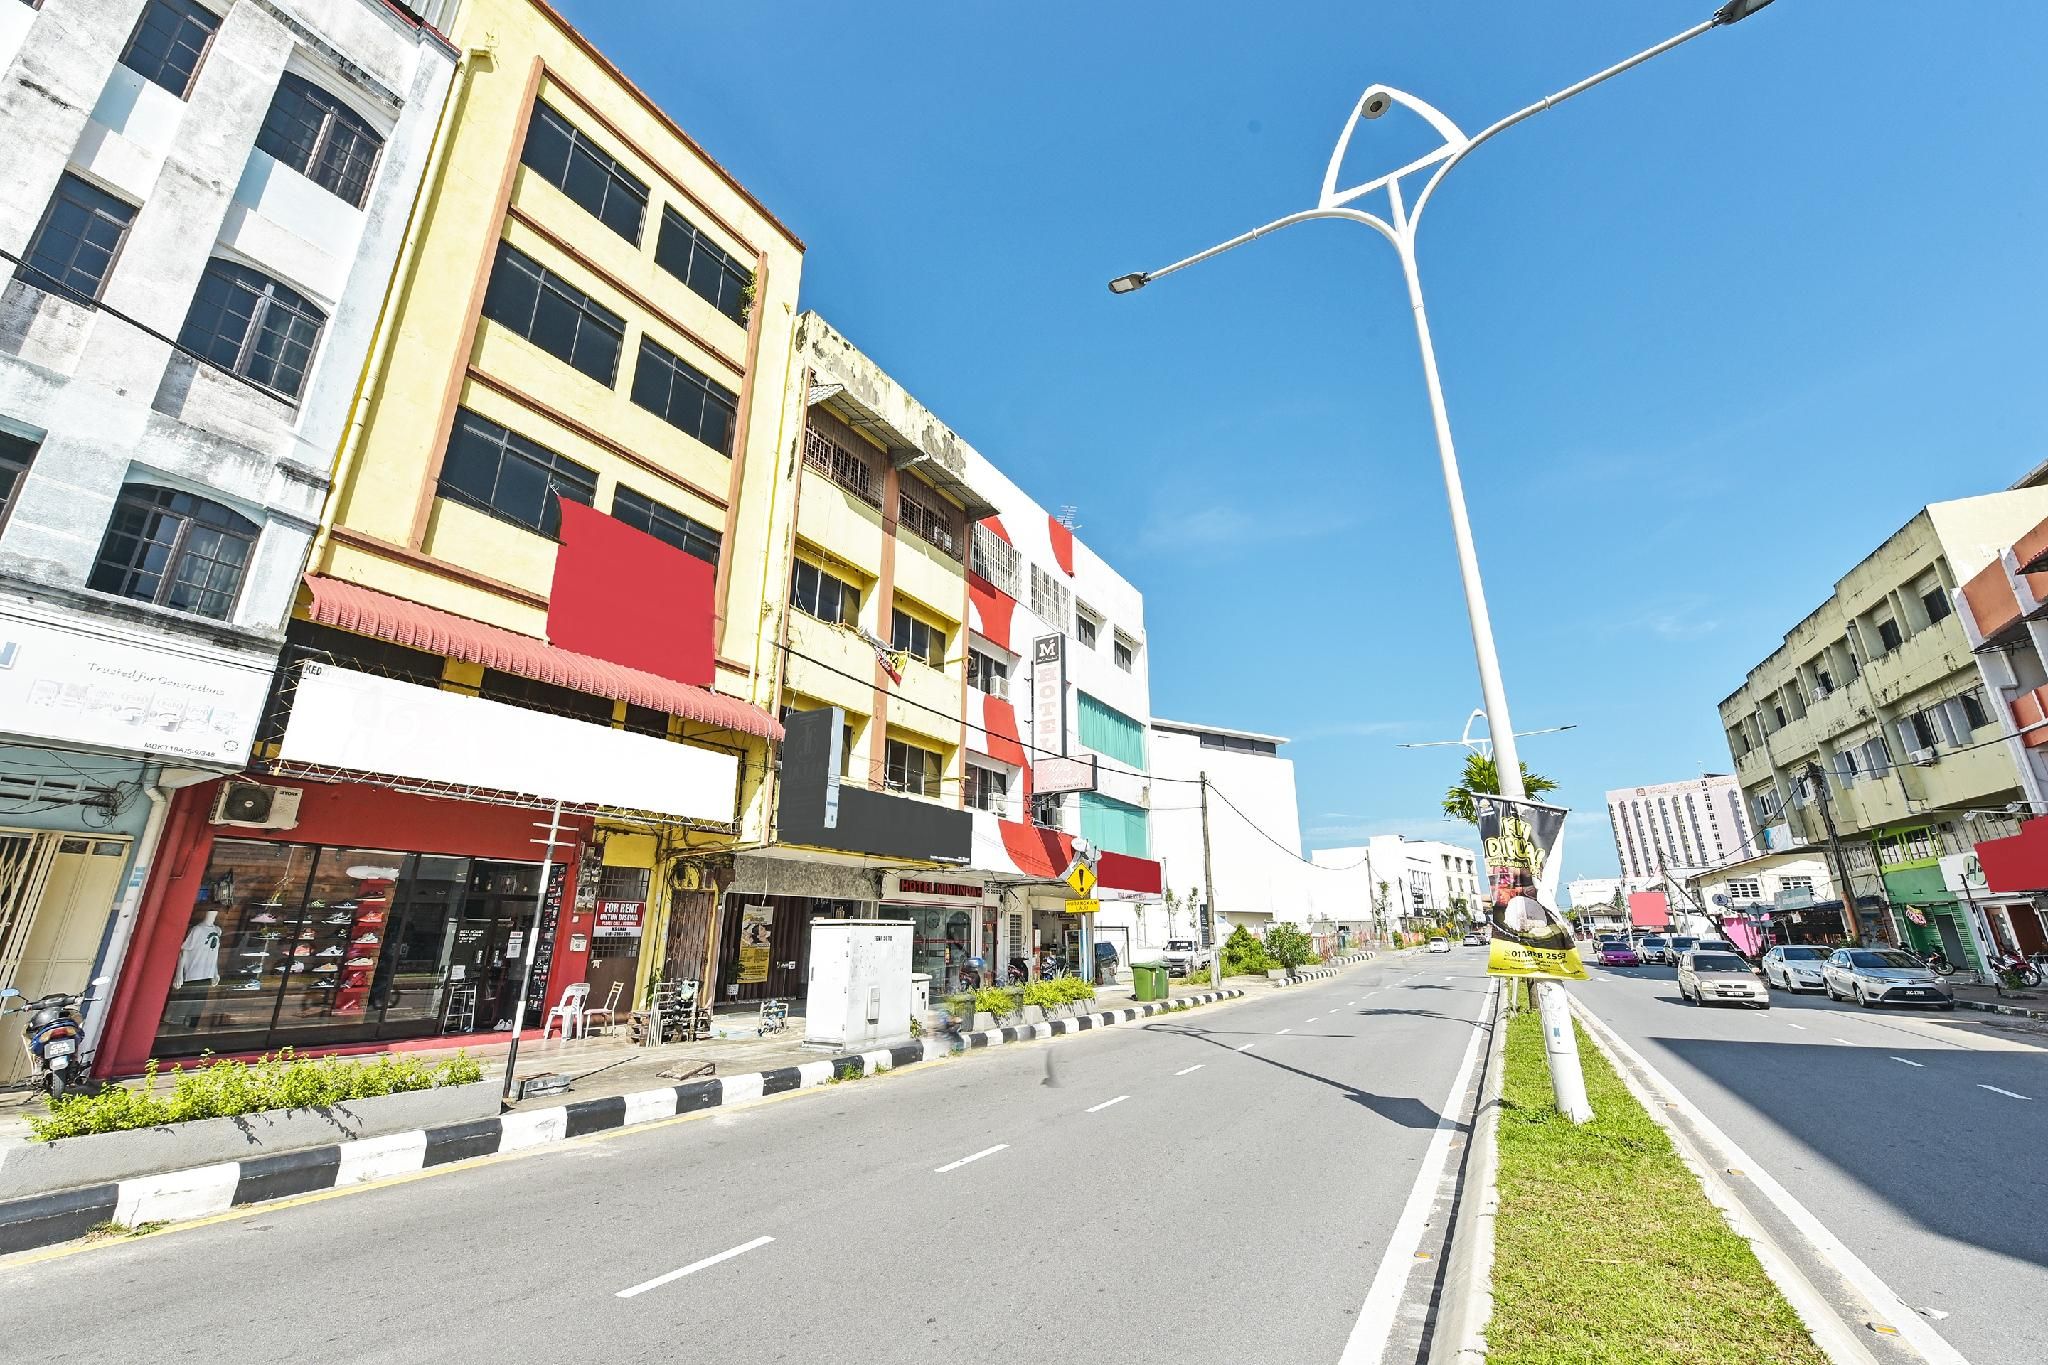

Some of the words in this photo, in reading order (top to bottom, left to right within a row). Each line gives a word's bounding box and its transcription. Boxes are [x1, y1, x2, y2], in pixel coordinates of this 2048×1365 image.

[88, 662, 137, 679] Trusted
[134, 672, 156, 682] for
[1038, 668, 1056, 751] HOTEL
[901, 880, 934, 894] HOTEL
[936, 883, 956, 896] MINI
[957, 884, 982, 897] INDAH
[600, 913, 618, 921] UNTUK
[604, 903, 620, 913] FOR
[620, 903, 639, 914] RENT
